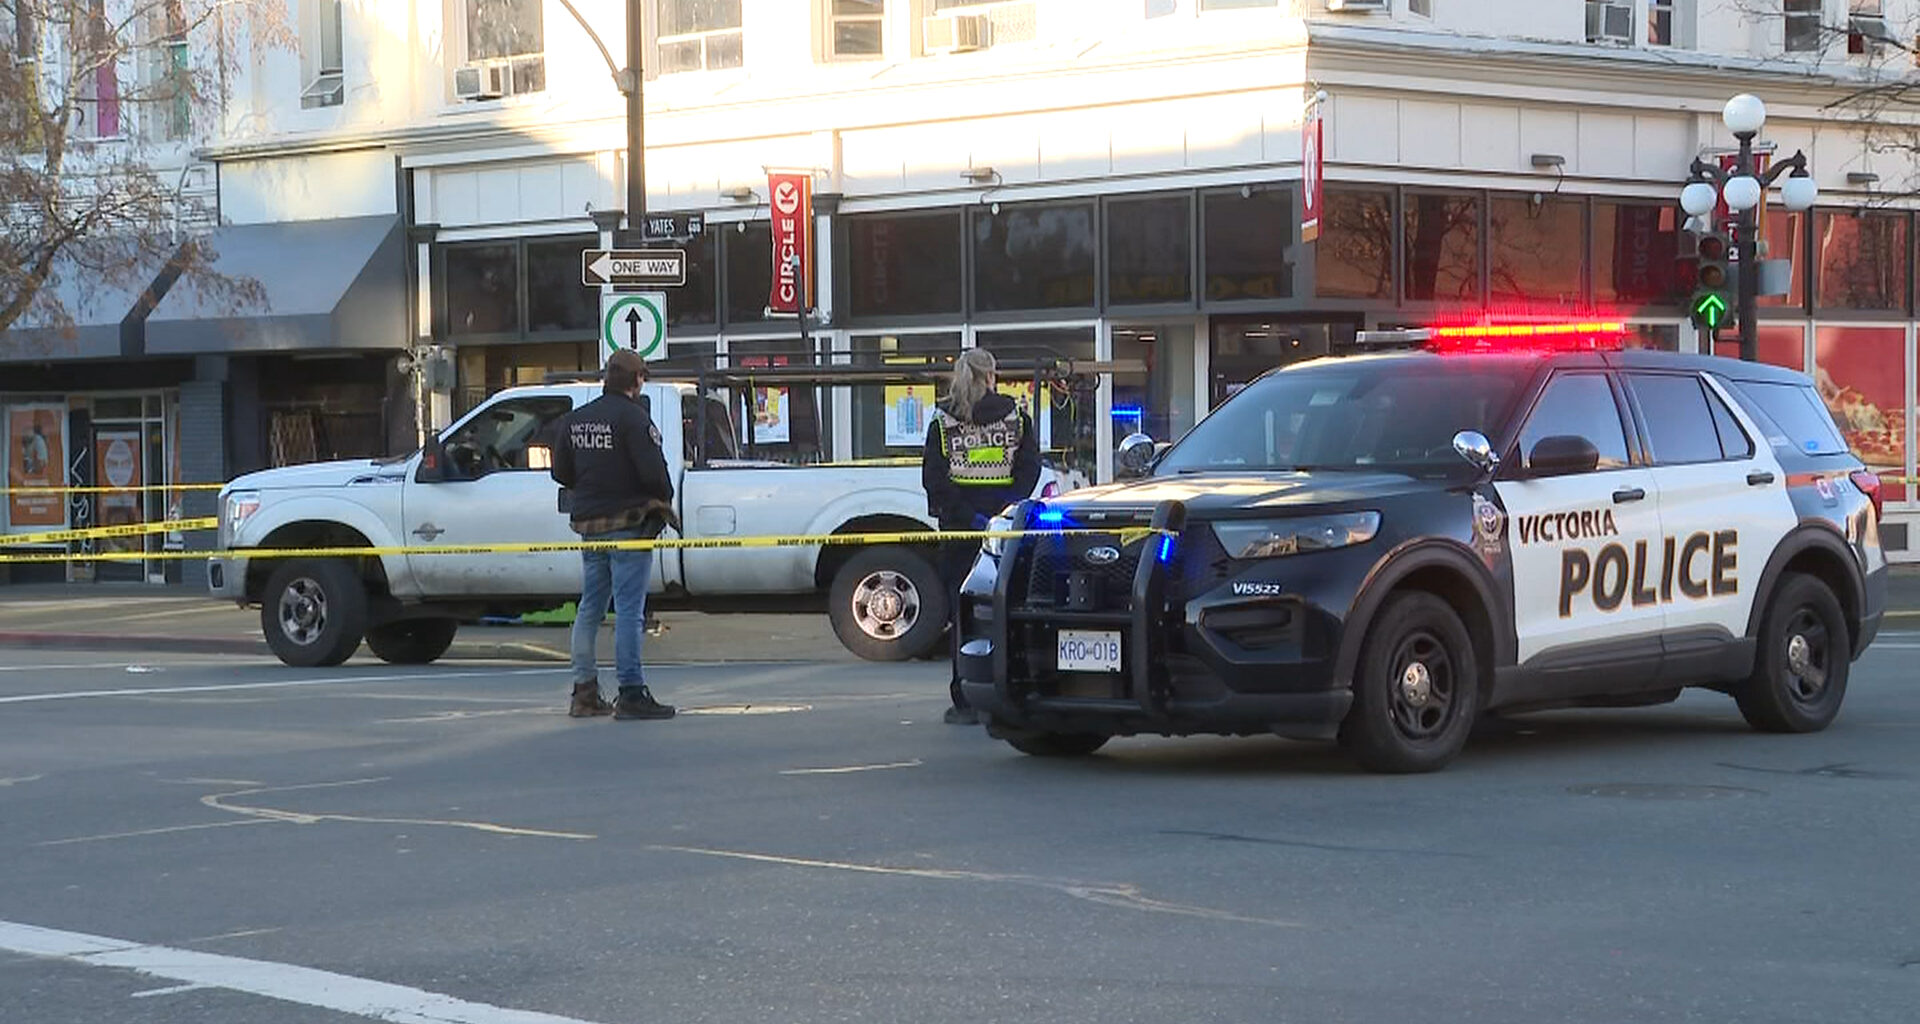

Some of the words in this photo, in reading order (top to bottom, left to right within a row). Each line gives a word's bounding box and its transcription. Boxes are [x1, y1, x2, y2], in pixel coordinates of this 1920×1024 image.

[648, 218, 675, 234] YATES
[611, 261, 641, 274] ONE
[646, 261, 675, 274] WAY
[780, 218, 796, 302] CIRCLE
[570, 422, 612, 434] VICTORIA
[570, 434, 613, 449] POLICE
[951, 431, 1016, 451] POLICE
[1518, 508, 1619, 545] VICTORIA
[1558, 528, 1739, 620] POLICE
[1233, 582, 1280, 595] VI5522
